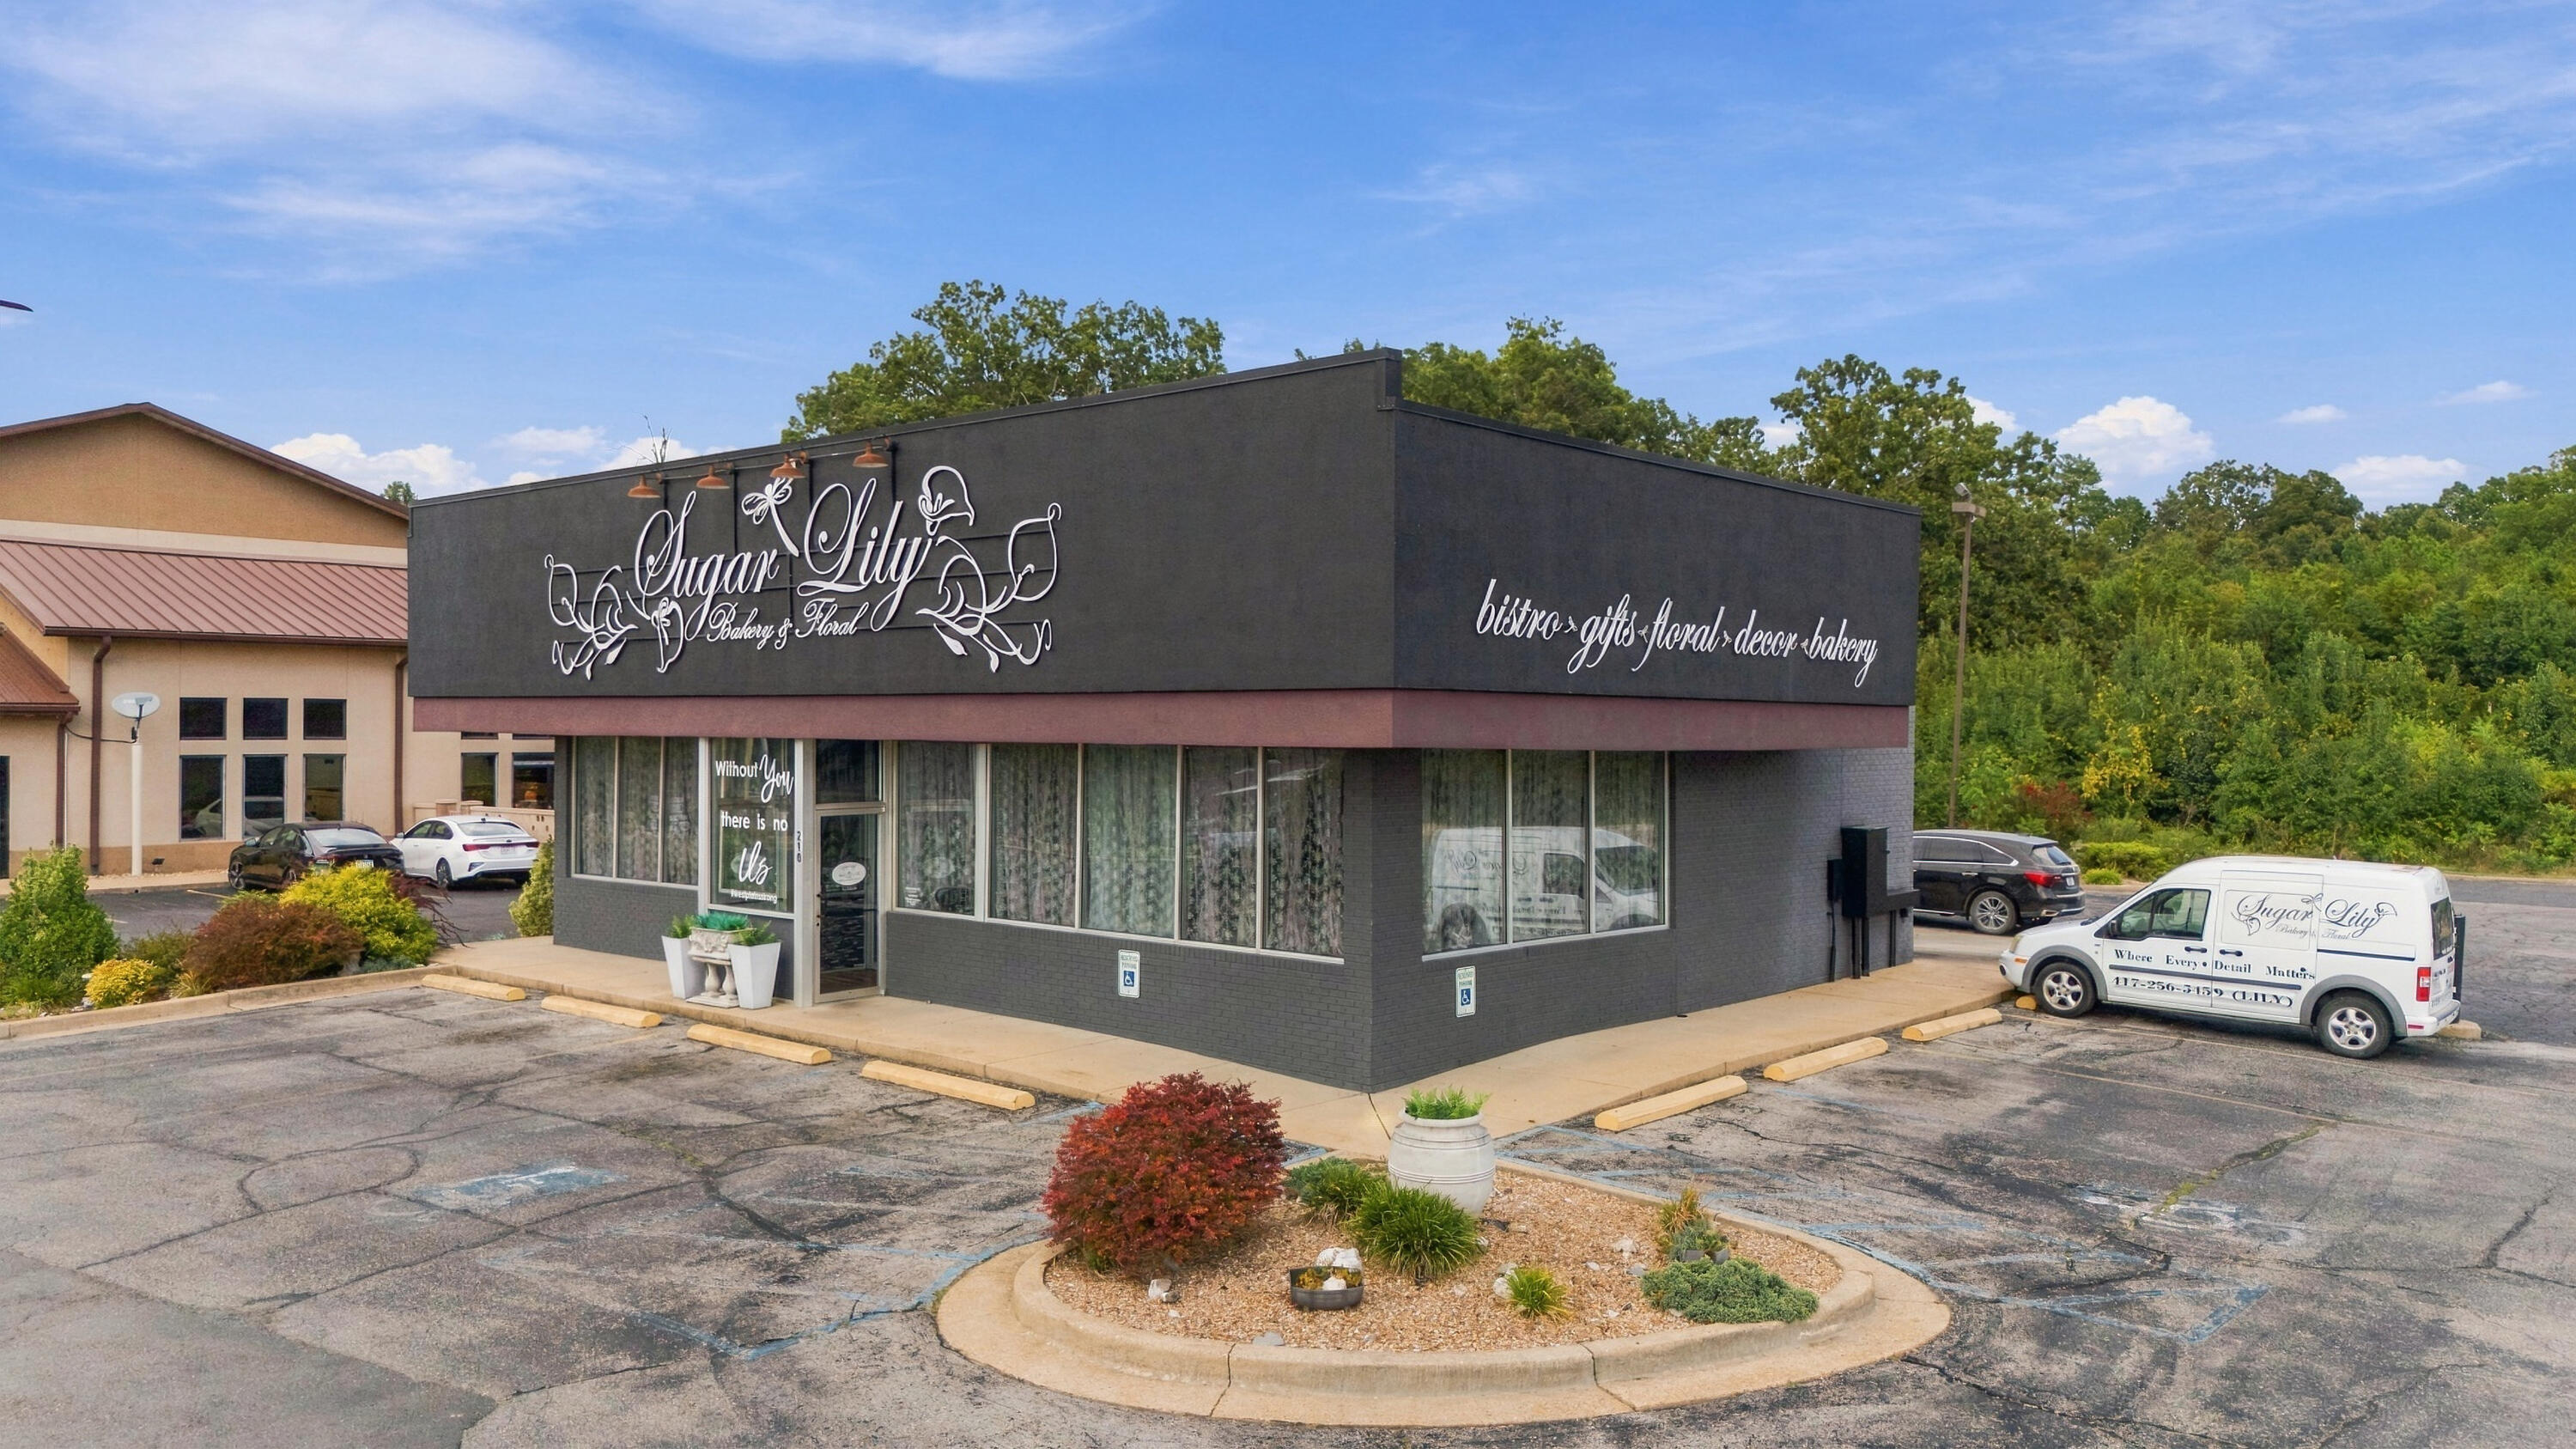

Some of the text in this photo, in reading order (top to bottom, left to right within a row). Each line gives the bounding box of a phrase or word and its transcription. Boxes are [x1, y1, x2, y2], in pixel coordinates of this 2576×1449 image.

[634, 478, 933, 641] Sugar Lily
[706, 598, 870, 650] Bakery & Floral
[1476, 579, 1878, 688] bistro gifts floral decor bakery
[715, 753, 794, 804] Without You
[720, 810, 788, 831] there is no
[738, 840, 774, 885] Us
[2236, 893, 2382, 939] Sugar Lily
[2275, 924, 2309, 940] Bakery
[2321, 928, 2353, 941] Floral
[2114, 949, 2316, 981] Where Every Detail Matters
[2111, 976, 2293, 1008] 417-256-5459 (LILY)
